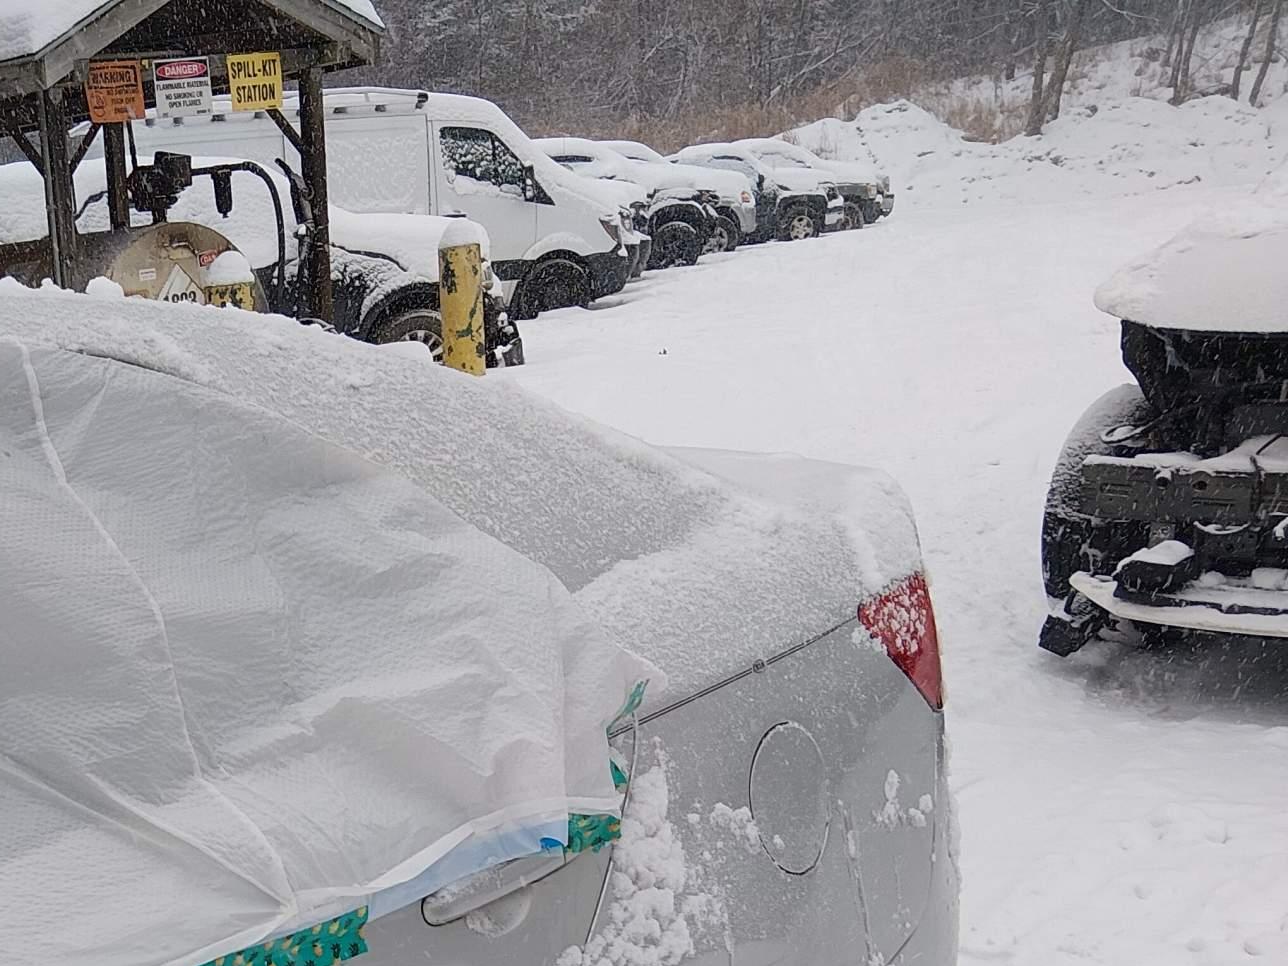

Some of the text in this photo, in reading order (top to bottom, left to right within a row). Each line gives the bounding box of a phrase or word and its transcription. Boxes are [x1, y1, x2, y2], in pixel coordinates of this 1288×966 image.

[165, 64, 199, 76] DANGER
[230, 59, 277, 79] SPILL-KIT
[90, 70, 132, 84] WARNING
[173, 91, 196, 100] SMOKING
[236, 83, 276, 103] STATION
[168, 100, 182, 109] OPEN
